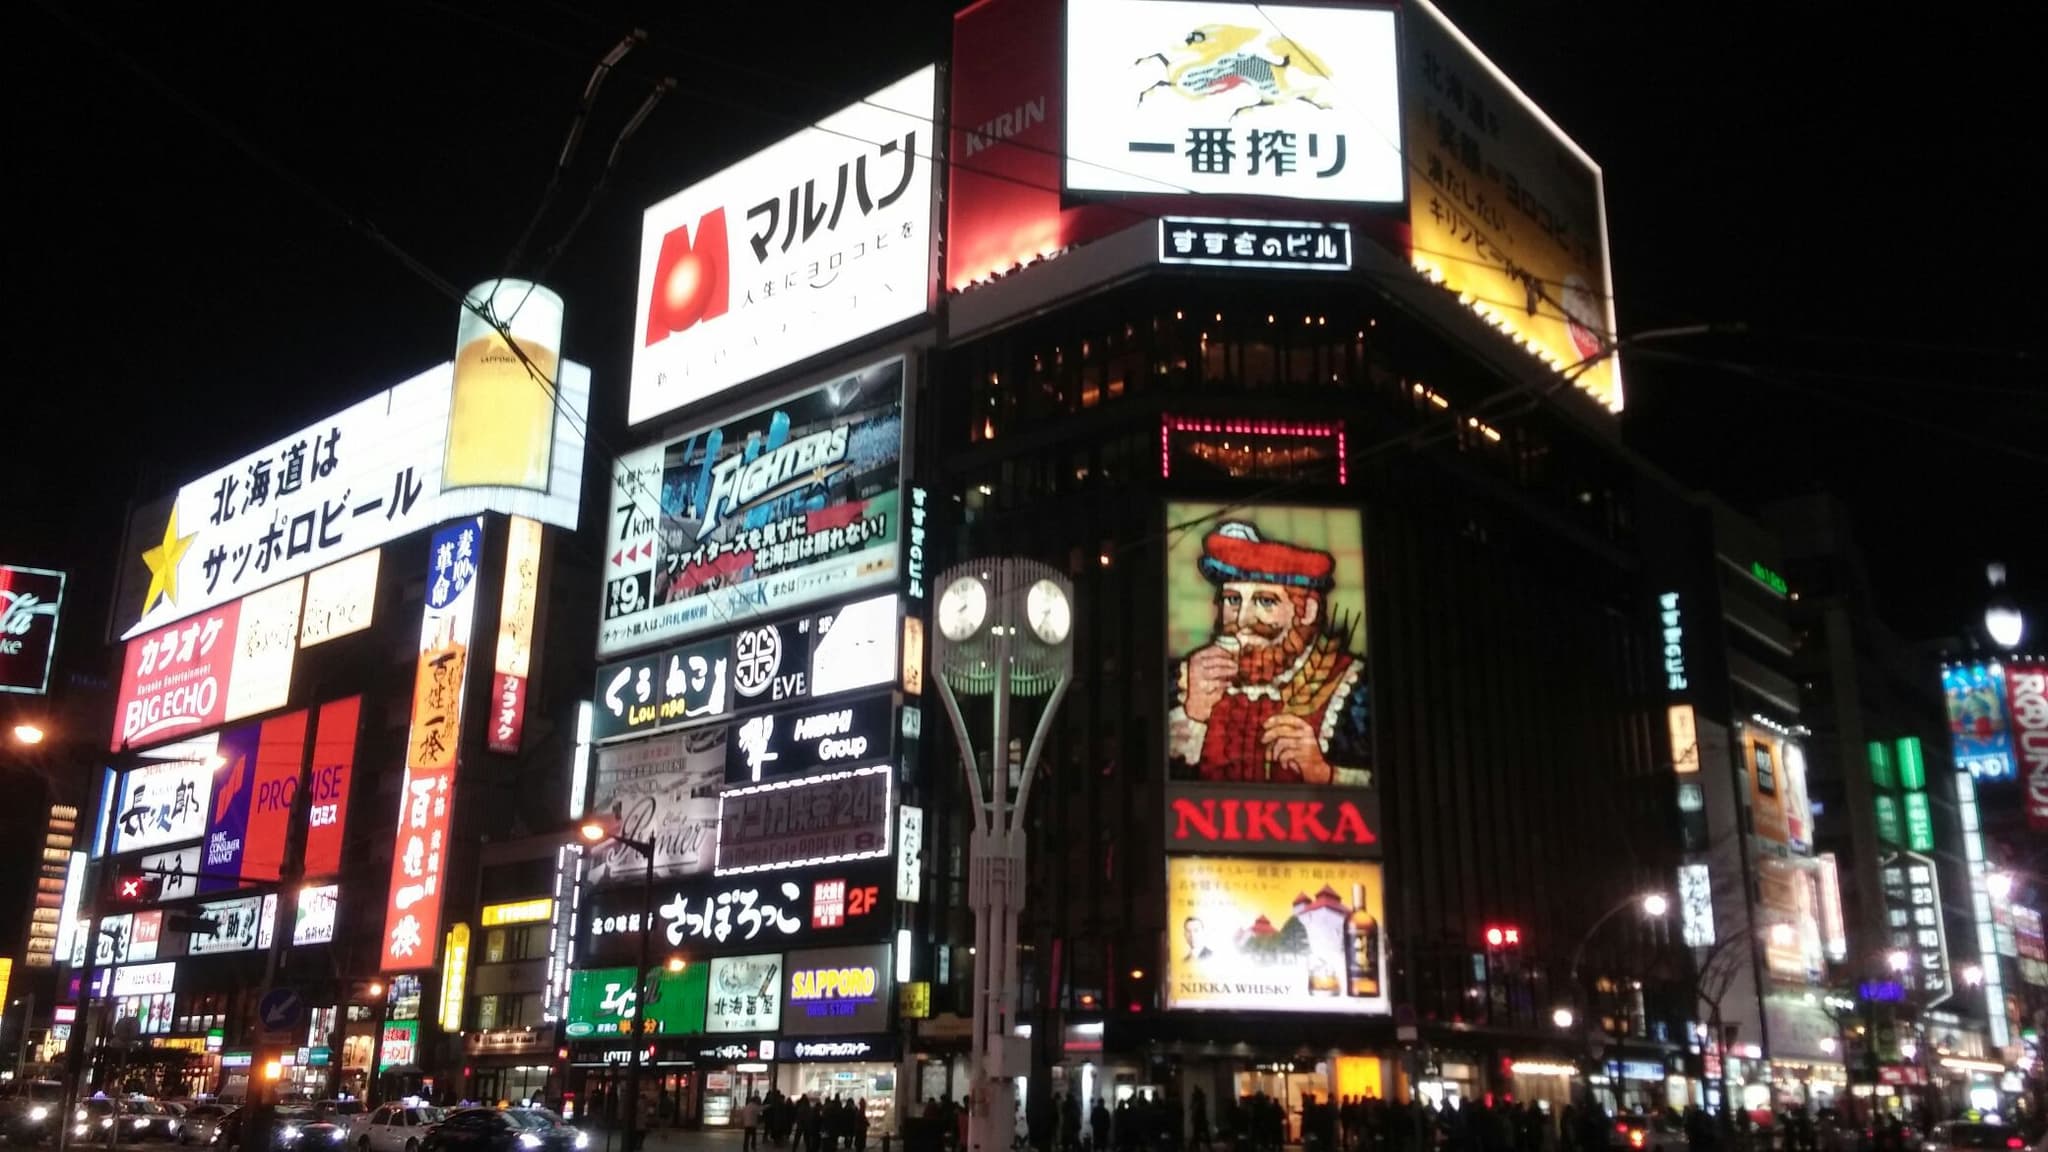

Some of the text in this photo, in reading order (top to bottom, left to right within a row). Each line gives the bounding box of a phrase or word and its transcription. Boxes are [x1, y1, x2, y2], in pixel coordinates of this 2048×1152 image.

[966, 96, 1047, 157] KIRIN
[1128, 126, 1347, 178] 一番搾り
[747, 130, 916, 264] マルハン
[1172, 228, 1338, 259] すすきのビル
[210, 428, 341, 526] 北海道は
[696, 422, 850, 541] FIGHTERS
[203, 467, 424, 595] サッポロビール
[616, 502, 656, 541] 7km
[666, 513, 808, 576] ファイターズを見ずに
[137, 615, 225, 678] カラオケ
[123, 676, 218, 741] BIG ECHO
[497, 676, 519, 741] カラオケ
[629, 698, 686, 726] Lounge
[772, 671, 807, 701] EVE
[818, 736, 868, 761] Group
[257, 765, 344, 813] PROISE
[1172, 798, 1377, 844] NIKKA
[390, 777, 436, 960] 百姓一揆
[659, 882, 802, 945] さっぽろっこ
[848, 887, 879, 916] 2F
[791, 966, 876, 999] SAPPORO
[1180, 982, 1292, 995] NIKKA WHISKY
[603, 1050, 650, 1063] LOTTEIA
